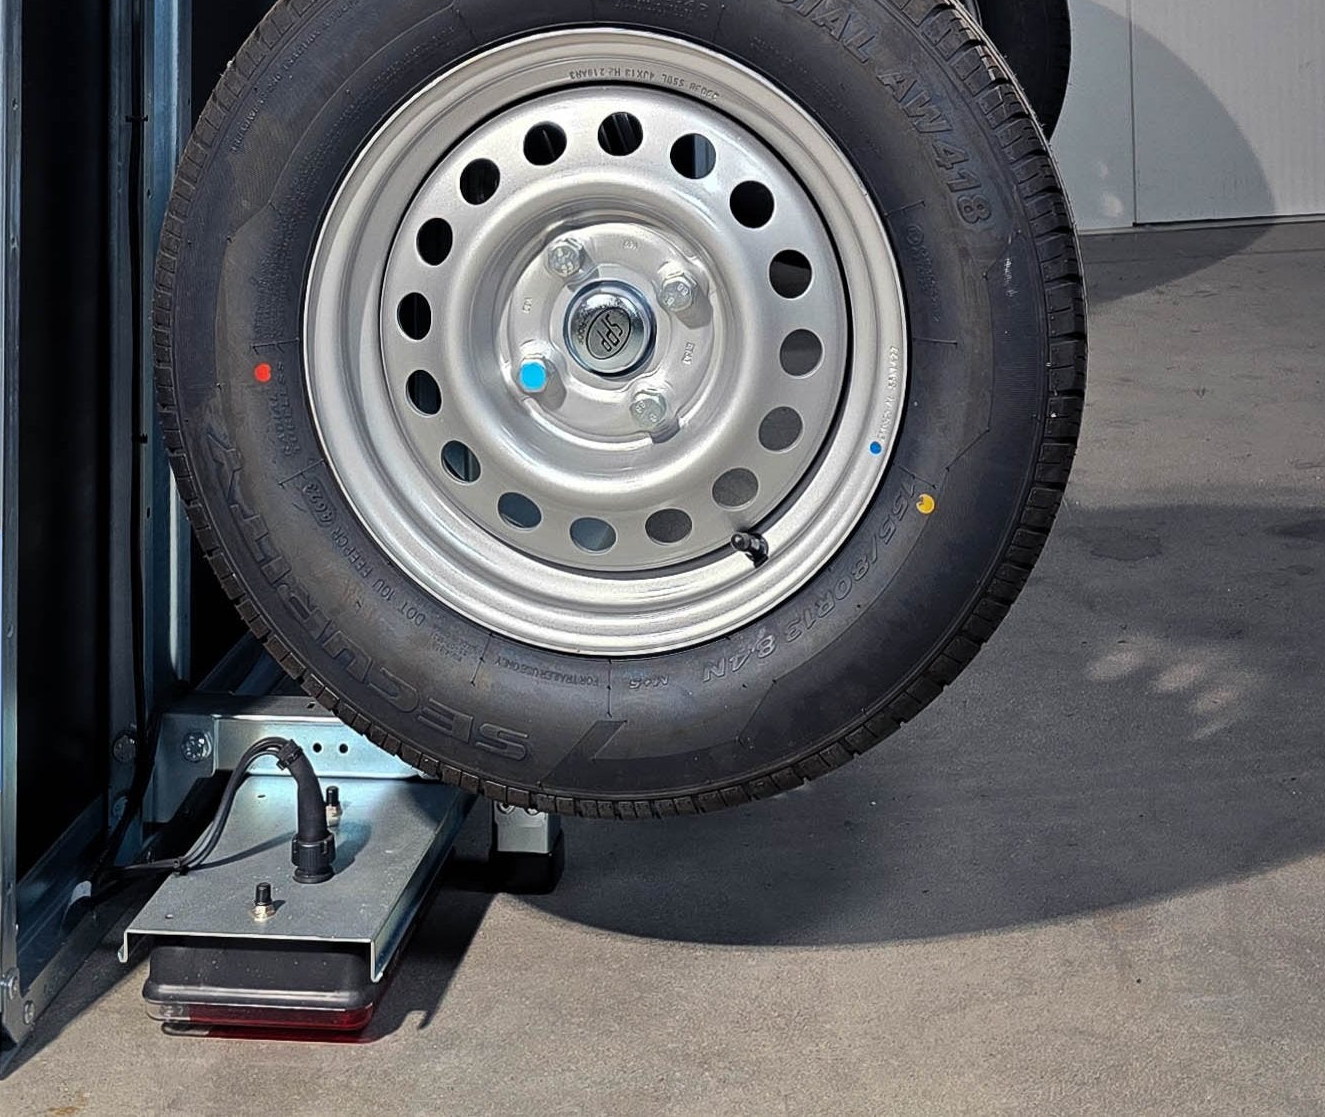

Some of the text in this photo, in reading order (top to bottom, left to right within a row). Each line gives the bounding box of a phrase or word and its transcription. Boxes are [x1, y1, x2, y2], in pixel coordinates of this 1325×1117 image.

[876, 66, 993, 225] AW418
[207, 433, 531, 761] SECURITY
[397, 601, 426, 626] DOT
[784, 480, 917, 644] 155/80R13
[701, 633, 778, 683] 84N
